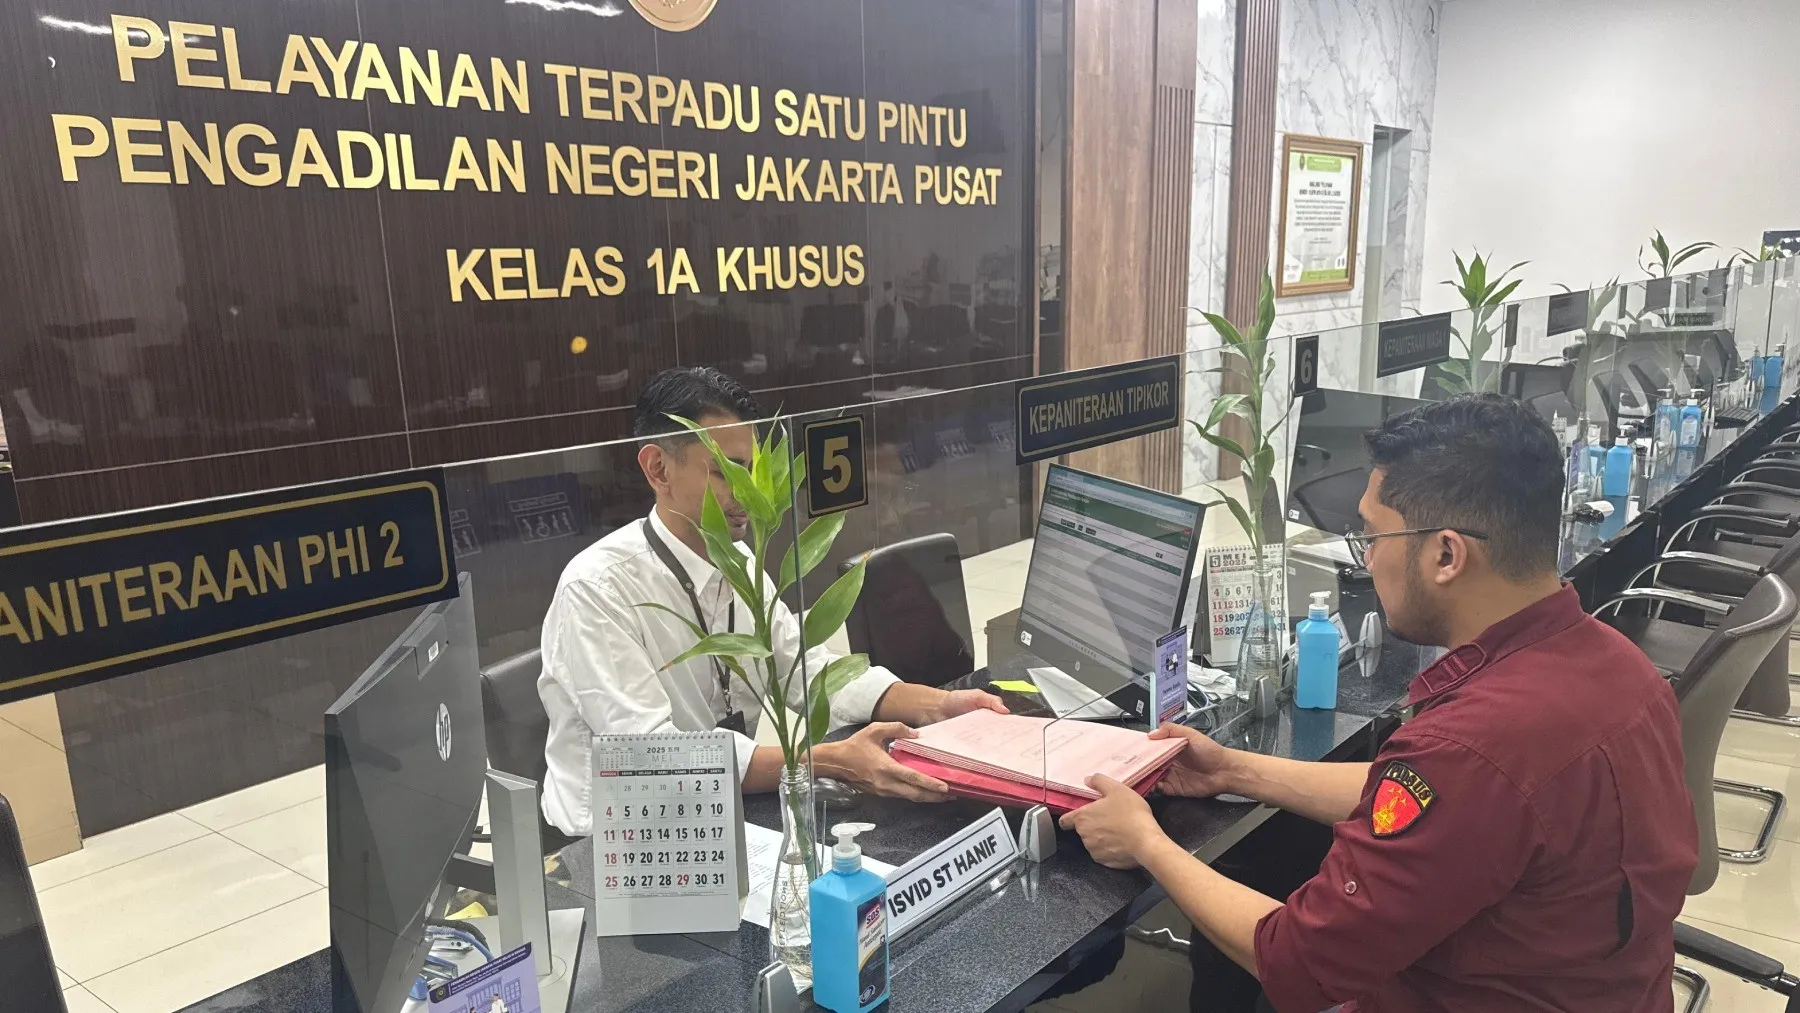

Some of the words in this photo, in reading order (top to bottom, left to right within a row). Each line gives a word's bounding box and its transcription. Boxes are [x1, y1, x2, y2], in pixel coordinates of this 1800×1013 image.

[111, 14, 530, 114] PELAYANAN
[544, 64, 760, 133] TERPADU
[774, 90, 866, 141] SATU
[877, 102, 967, 148] PINTU
[51, 113, 528, 194] PENGADILAN
[545, 143, 720, 200] NEGERI
[735, 155, 904, 204] JAKARTA
[914, 166, 1002, 206] PUSAT
[446, 246, 627, 302] KELAS
[646, 248, 700, 295] 1A
[716, 244, 866, 292] KHUSUS
[1301, 349, 1312, 384] 6
[1029, 389, 1124, 436] KEPANITERAAN
[1126, 381, 1170, 415] TIPIKOR
[822, 435, 852, 494] 5
[298, 526, 370, 585] PHI
[379, 521, 405, 568] 2
[678, 780, 682, 792] 1
[696, 780, 702, 792] 2
[714, 780, 720, 792] 3
[606, 806, 612, 818] 4
[624, 806, 630, 818] 5
[642, 806, 648, 816] 6
[660, 804, 666, 816] 7
[678, 804, 684, 816] 8
[696, 804, 702, 814] 9
[710, 802, 724, 814] 10
[604, 830, 614, 840] 11
[622, 828, 634, 840] 12
[640, 828, 652, 840] 13
[658, 828, 670, 840] 14
[676, 828, 688, 840] 15
[694, 828, 706, 838] 16
[710, 826, 724, 838] 17
[604, 852, 618, 864] 18
[622, 852, 634, 864] 19
[640, 852, 652, 864] 20
[658, 852, 670, 862] 21
[676, 850, 688, 862] 22
[694, 850, 706, 862] 23
[712, 850, 724, 862] 24
[887, 877, 932, 917] ISVID
[932, 862, 953, 889] ST
[953, 834, 998, 876] HANIF
[606, 876, 618, 888] 25
[624, 876, 636, 886] 26
[642, 876, 654, 886] 27
[658, 874, 672, 886] 28
[676, 874, 690, 886] 29
[694, 874, 708, 884] 30
[712, 874, 724, 884] 31
[866, 906, 880, 925] SOS
